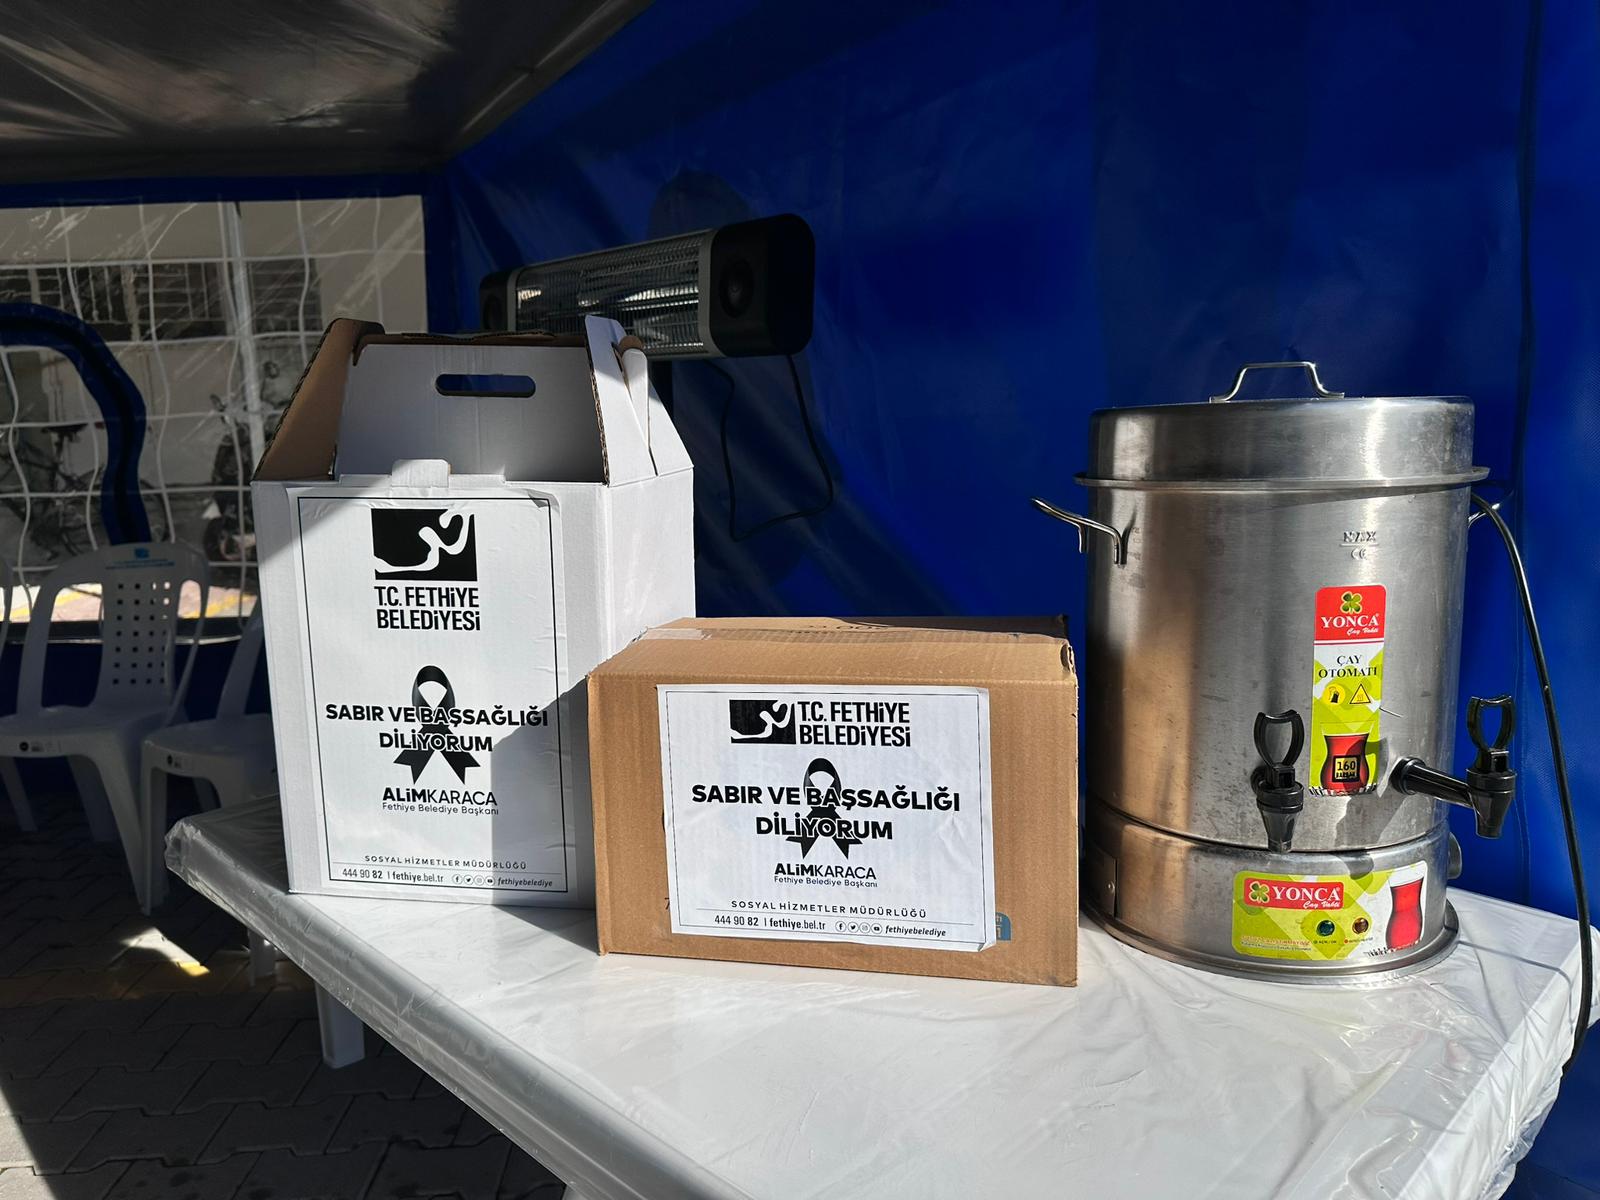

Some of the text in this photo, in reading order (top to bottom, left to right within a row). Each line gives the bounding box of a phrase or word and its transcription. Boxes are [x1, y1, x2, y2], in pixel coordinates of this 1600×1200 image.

[374, 586, 402, 606] T.C.
[1321, 614, 1379, 628] YONCA
[1336, 655, 1362, 666] ÇAY
[326, 704, 548, 728] SABIR VE BAŞSAĞLIĞI
[797, 701, 827, 722] T.C.
[379, 728, 493, 752] DİLİYORUM
[1337, 760, 1356, 771] 160
[692, 784, 960, 812] SABIR VE BAŞSAĞLIĞI
[382, 803, 499, 816] Fethiye Belediye Başkanı
[756, 811, 893, 840] DİLİYORUM
[364, 855, 527, 870] SOSYAL HİZMETLER MÜDÜRLÜĞÜ
[342, 868, 358, 878] 444
[359, 869, 370, 878] 90
[372, 870, 383, 879] 82
[392, 870, 444, 883] fethiye.bel.tr
[497, 878, 553, 888] fethiyebelediye
[774, 876, 878, 888] Fethiye Belediye Başkanı
[1272, 886, 1341, 901] YONCA
[731, 900, 927, 918] SOSYAL HİZMETLER MÜDÜRLÜĞÜ
[714, 915, 731, 925] 444
[733, 916, 745, 926] 90
[747, 917, 759, 926] 82
[769, 917, 826, 930] fethiye.bel.tr
[885, 925, 946, 937] fethiyebelediye
